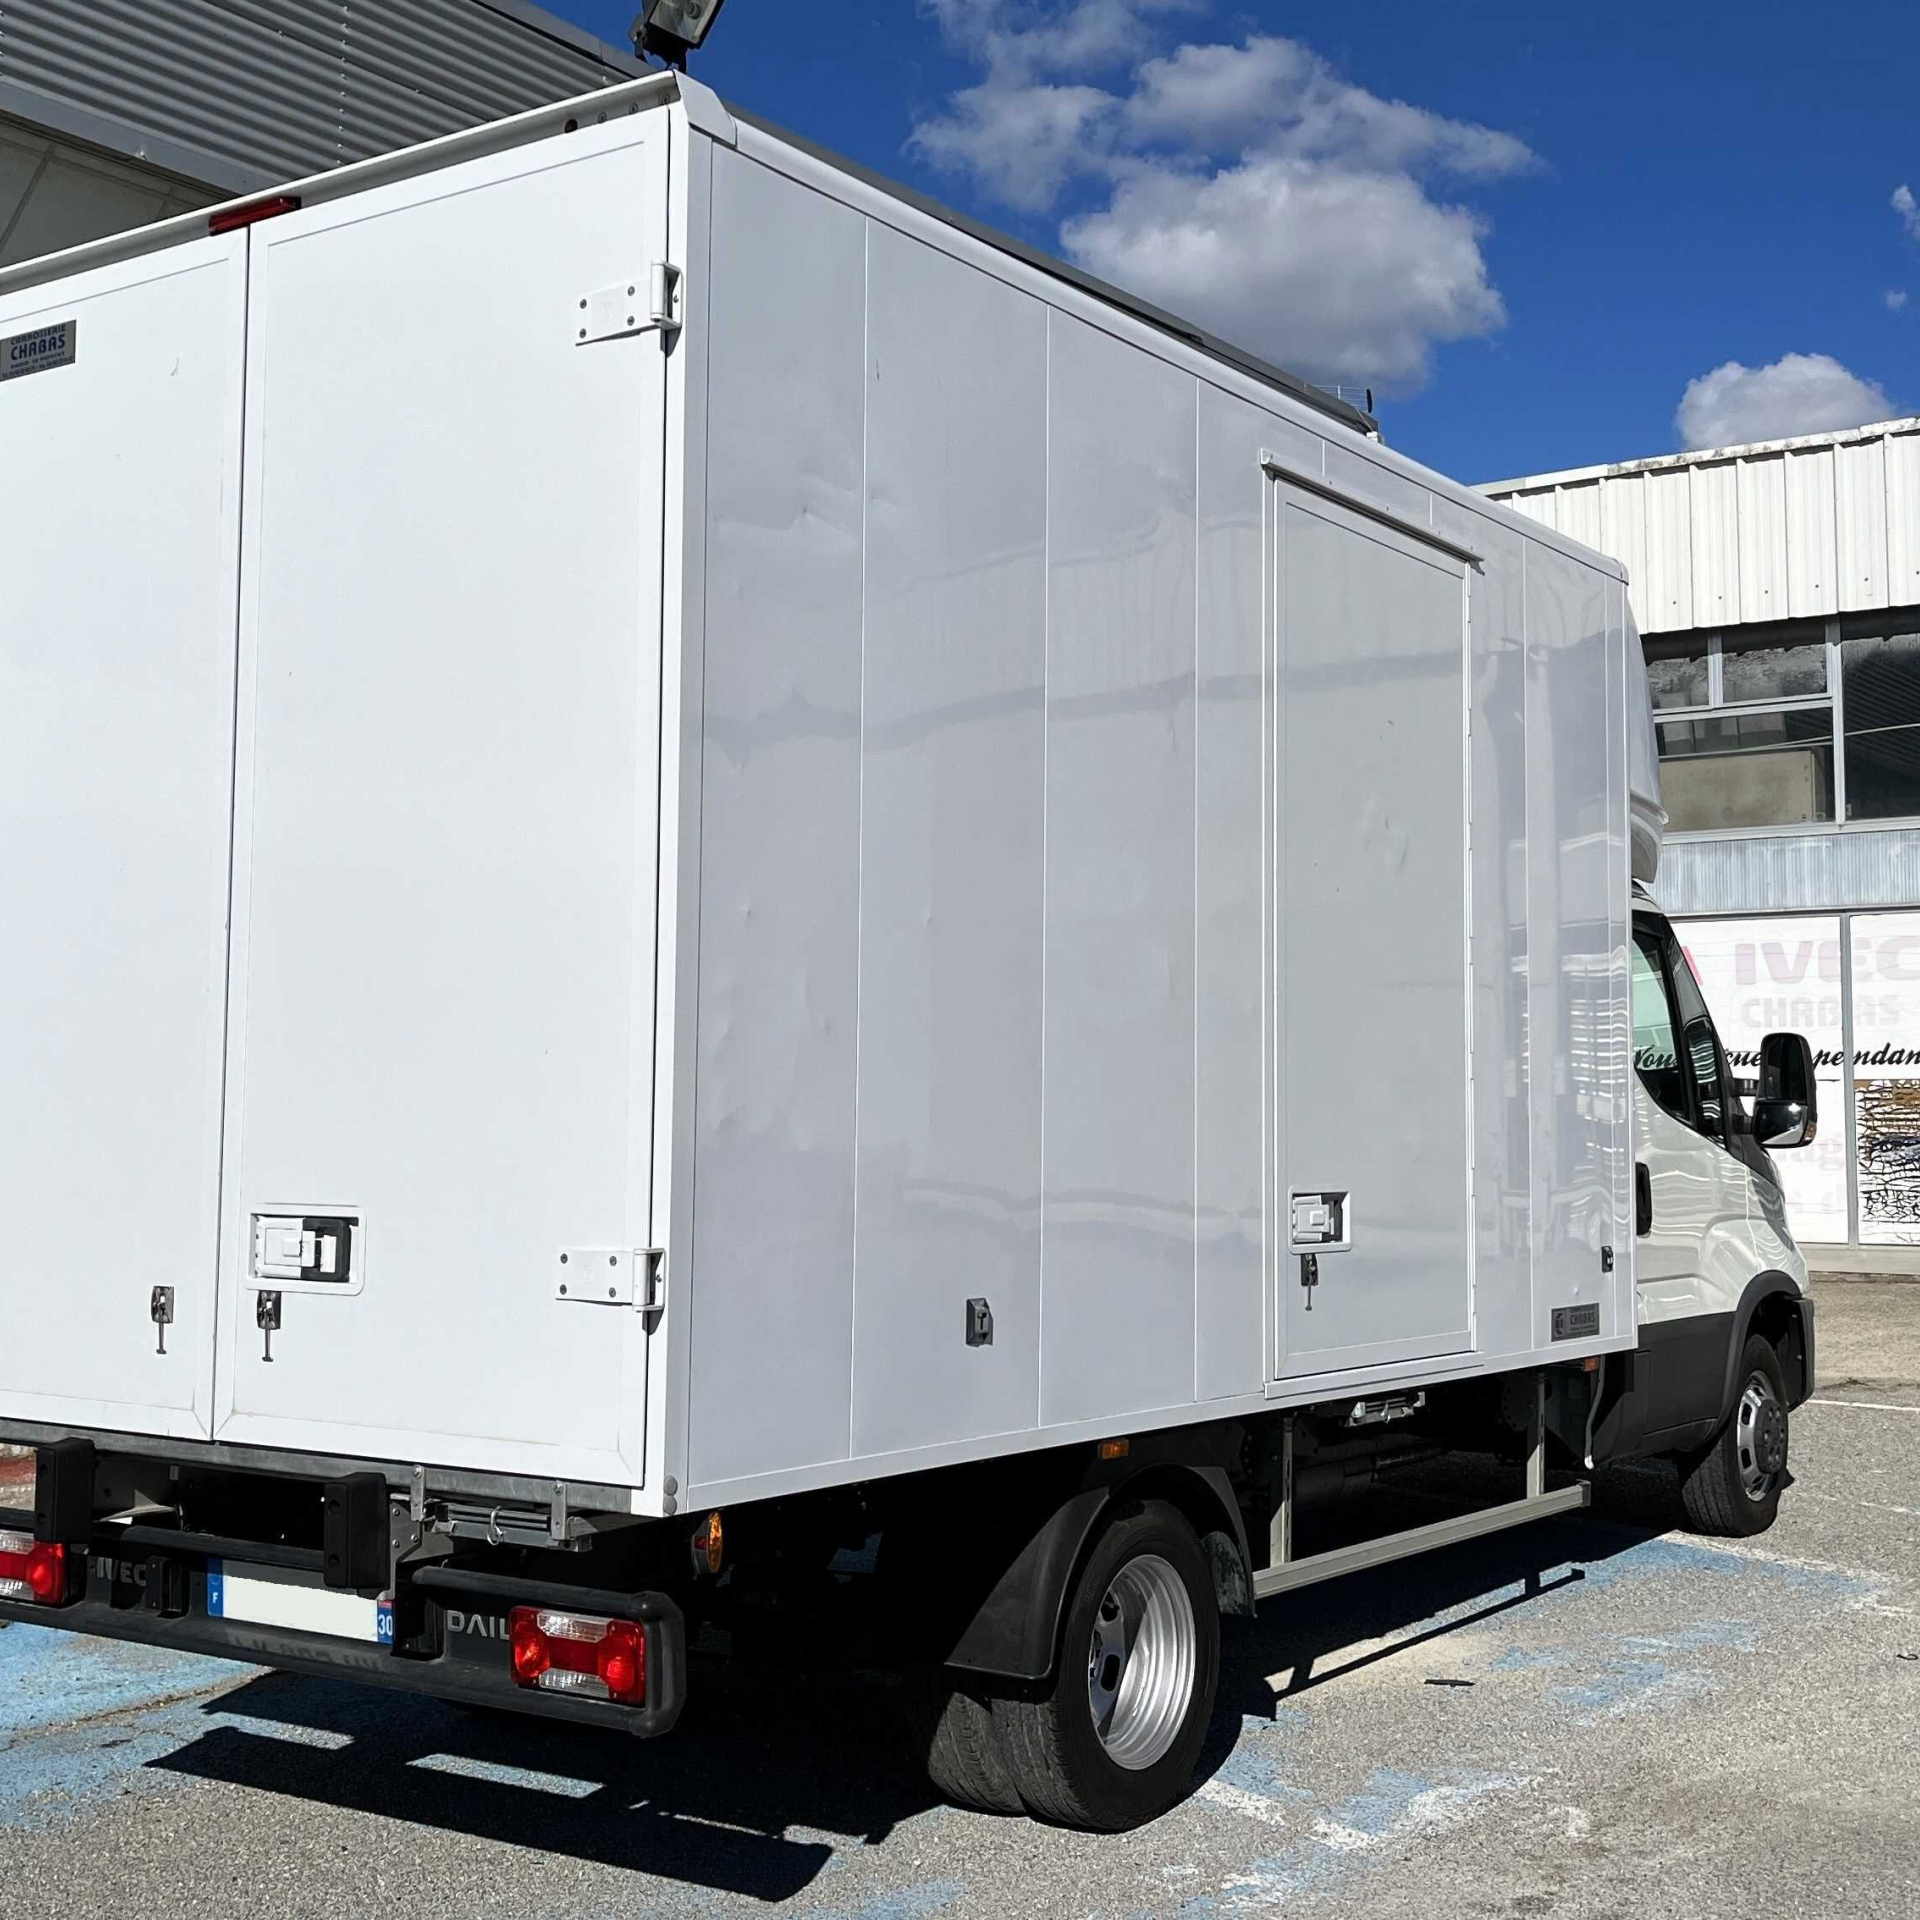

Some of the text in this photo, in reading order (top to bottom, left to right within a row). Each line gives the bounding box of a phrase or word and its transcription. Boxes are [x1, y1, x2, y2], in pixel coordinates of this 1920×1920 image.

[10, 334, 66, 360] CHABAS
[1735, 935, 1920, 985] IVEC
[1741, 994, 1900, 1028] CHABAS
[96, 1557, 147, 1587] IVEC
[377, 1614, 393, 1636] 30
[447, 1609, 510, 1641] DAIL
